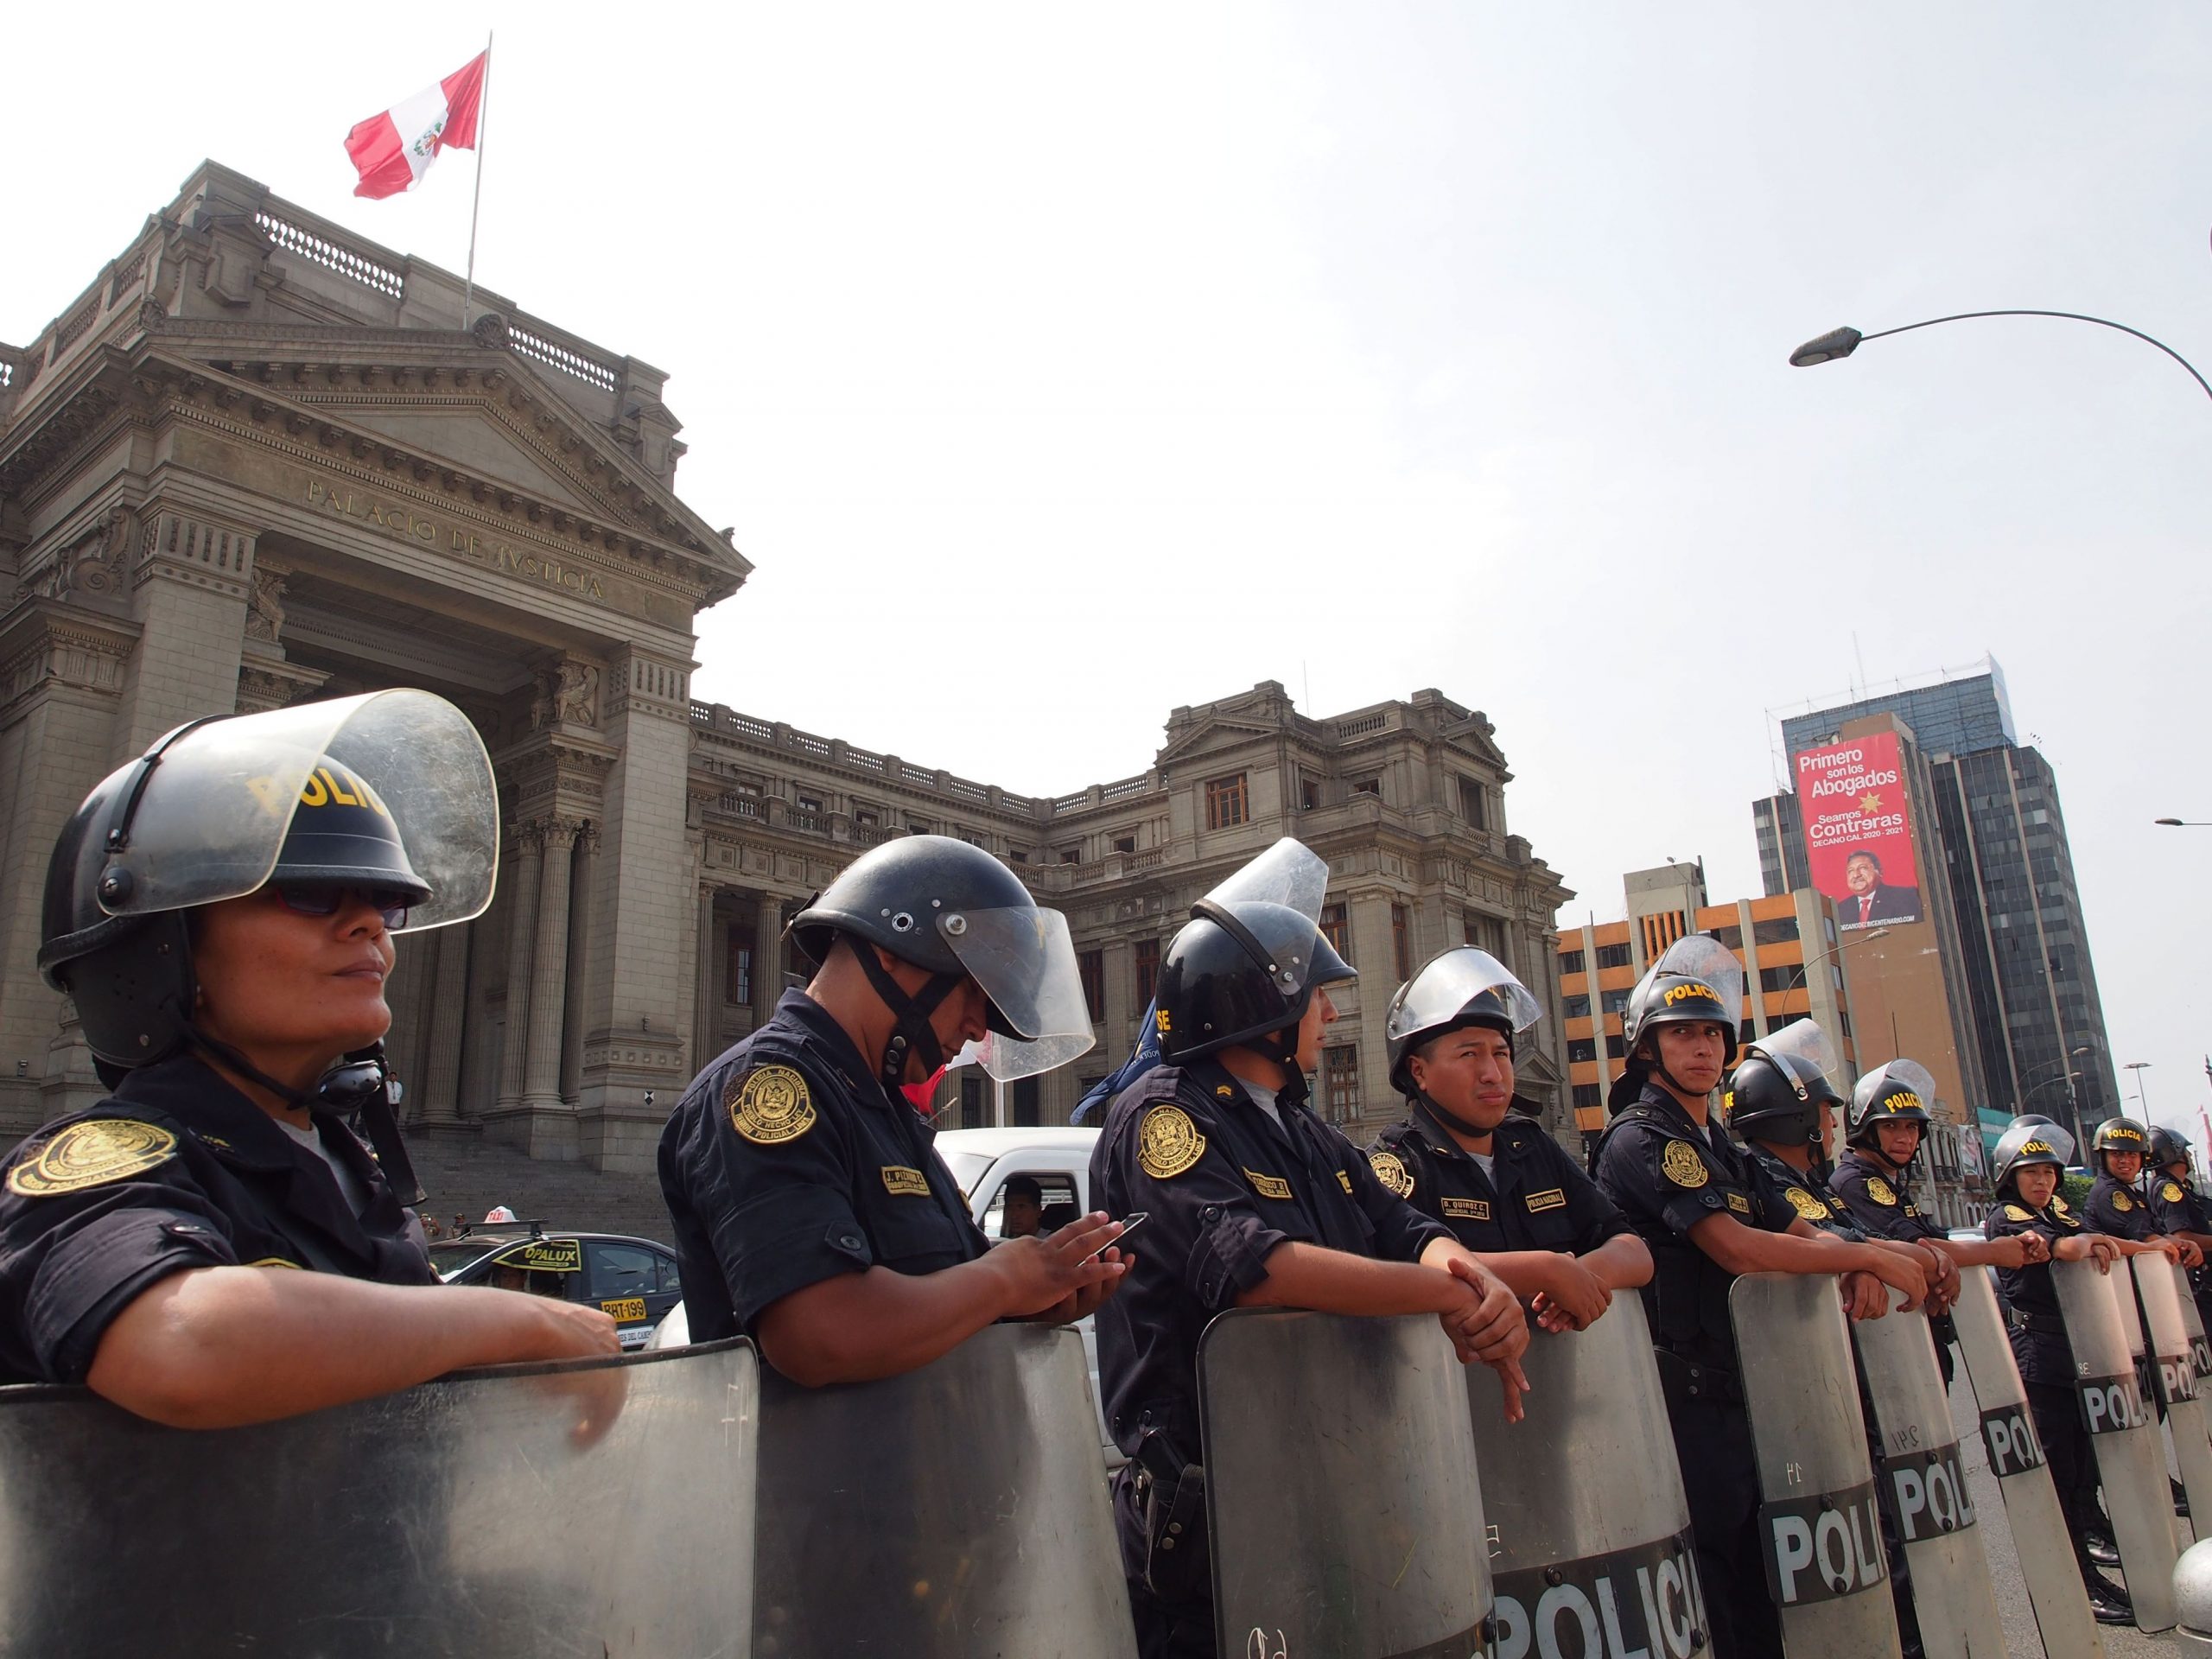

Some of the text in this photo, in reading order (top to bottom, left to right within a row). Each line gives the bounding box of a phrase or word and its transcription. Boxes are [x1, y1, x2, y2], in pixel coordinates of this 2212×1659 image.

[306, 480, 436, 542] PALACIO
[451, 529, 483, 559] DE
[1800, 748, 1863, 772] Primero
[1827, 764, 1864, 779] son los
[1811, 770, 1897, 798] Abogados
[1809, 813, 1903, 839] Contreras
[1818, 810, 1861, 824] Seamos
[1813, 836, 1846, 848] DECANO
[1846, 834, 1862, 843] CAL
[1863, 830, 1881, 840] 2020
[1885, 826, 1904, 836] 2021
[747, 1069, 807, 1099] POLICIA NACIONAL
[1143, 1109, 1191, 1140] POLICIA NACIONAL
[755, 1129, 794, 1140] POLICIAL
[2107, 1128, 2141, 1141] POLICIA
[1452, 1201, 1478, 1211] QUIROZ
[489, 1211, 505, 1221] TAXI
[524, 1247, 576, 1262] OPALUX
